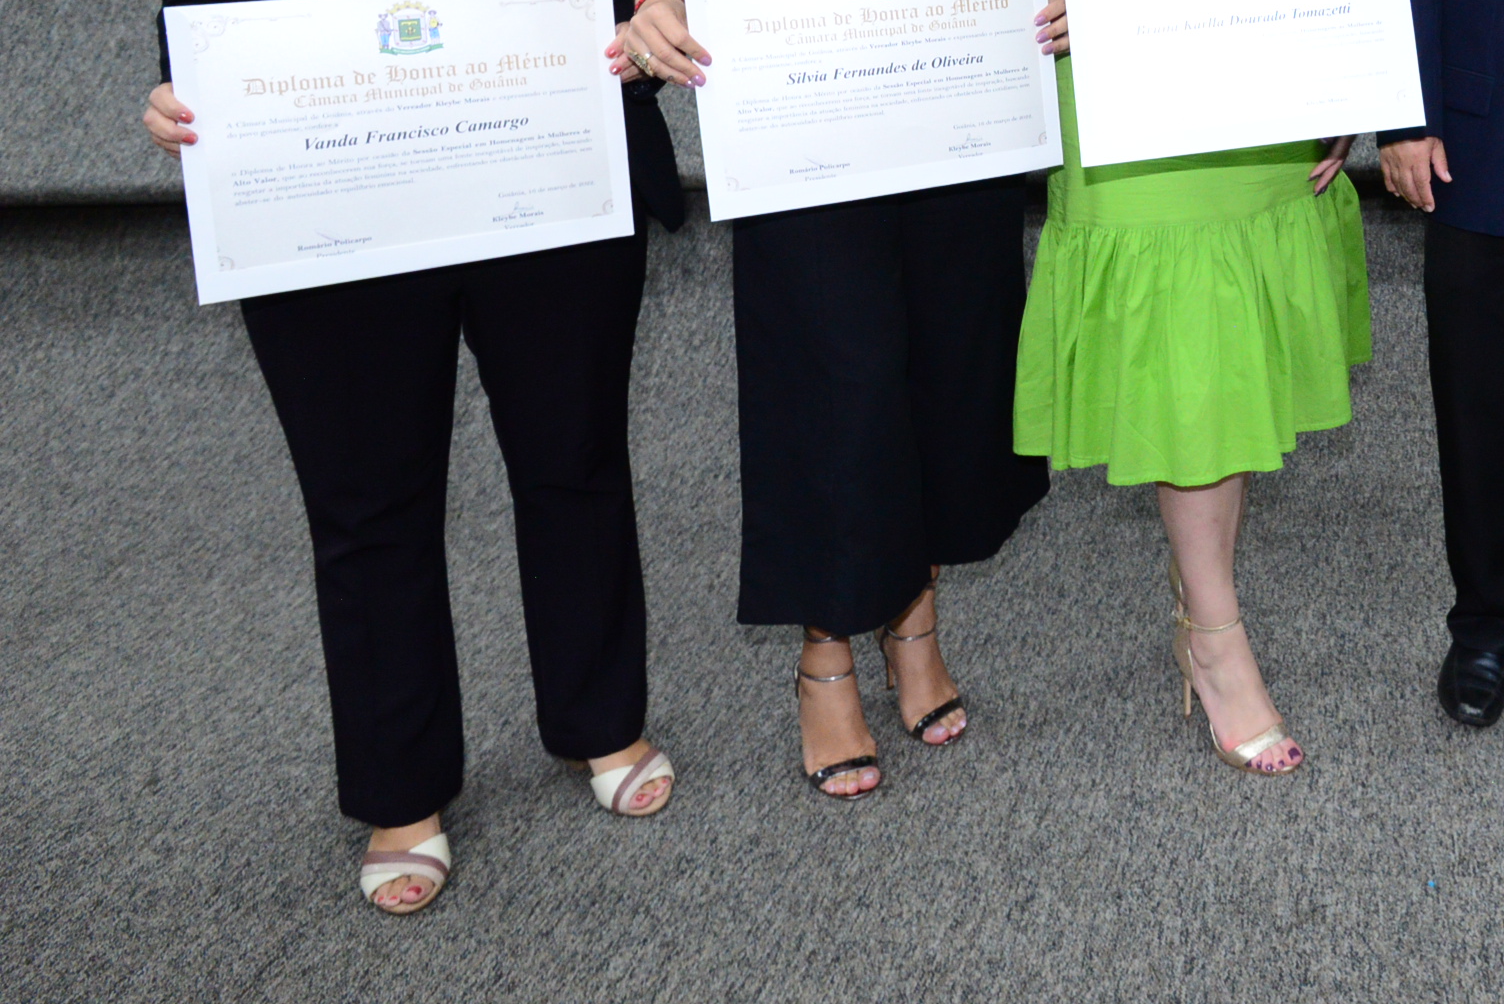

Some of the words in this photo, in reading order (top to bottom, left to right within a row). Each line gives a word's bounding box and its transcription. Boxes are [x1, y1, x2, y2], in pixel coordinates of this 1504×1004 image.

[743, 16, 826, 34] Diploma
[833, 11, 852, 26] de
[860, 7, 918, 25] Honra
[925, 5, 944, 17] ao
[1230, 10, 1287, 26] Dourado
[1292, 2, 1351, 20] Tomazetti
[784, 32, 837, 46] Câmara
[842, 23, 907, 41] Municipal
[910, 23, 924, 33] de
[928, 17, 977, 31] Goiânia
[242, 75, 345, 96] Diploma
[353, 70, 376, 86] de
[385, 64, 457, 85] Honra
[465, 62, 487, 75] ao
[496, 52, 567, 74] Mérito
[786, 70, 827, 85] Silvia
[833, 62, 907, 80] Fernandes
[911, 59, 927, 71] de
[931, 53, 983, 68] Oliveira
[293, 93, 358, 108] Câmara
[363, 82, 443, 103] Municipal
[448, 82, 463, 93] de
[469, 75, 527, 90] Goiânia
[305, 134, 358, 150] Vanda
[365, 125, 449, 144] Francisco
[455, 117, 529, 133] Camargo
